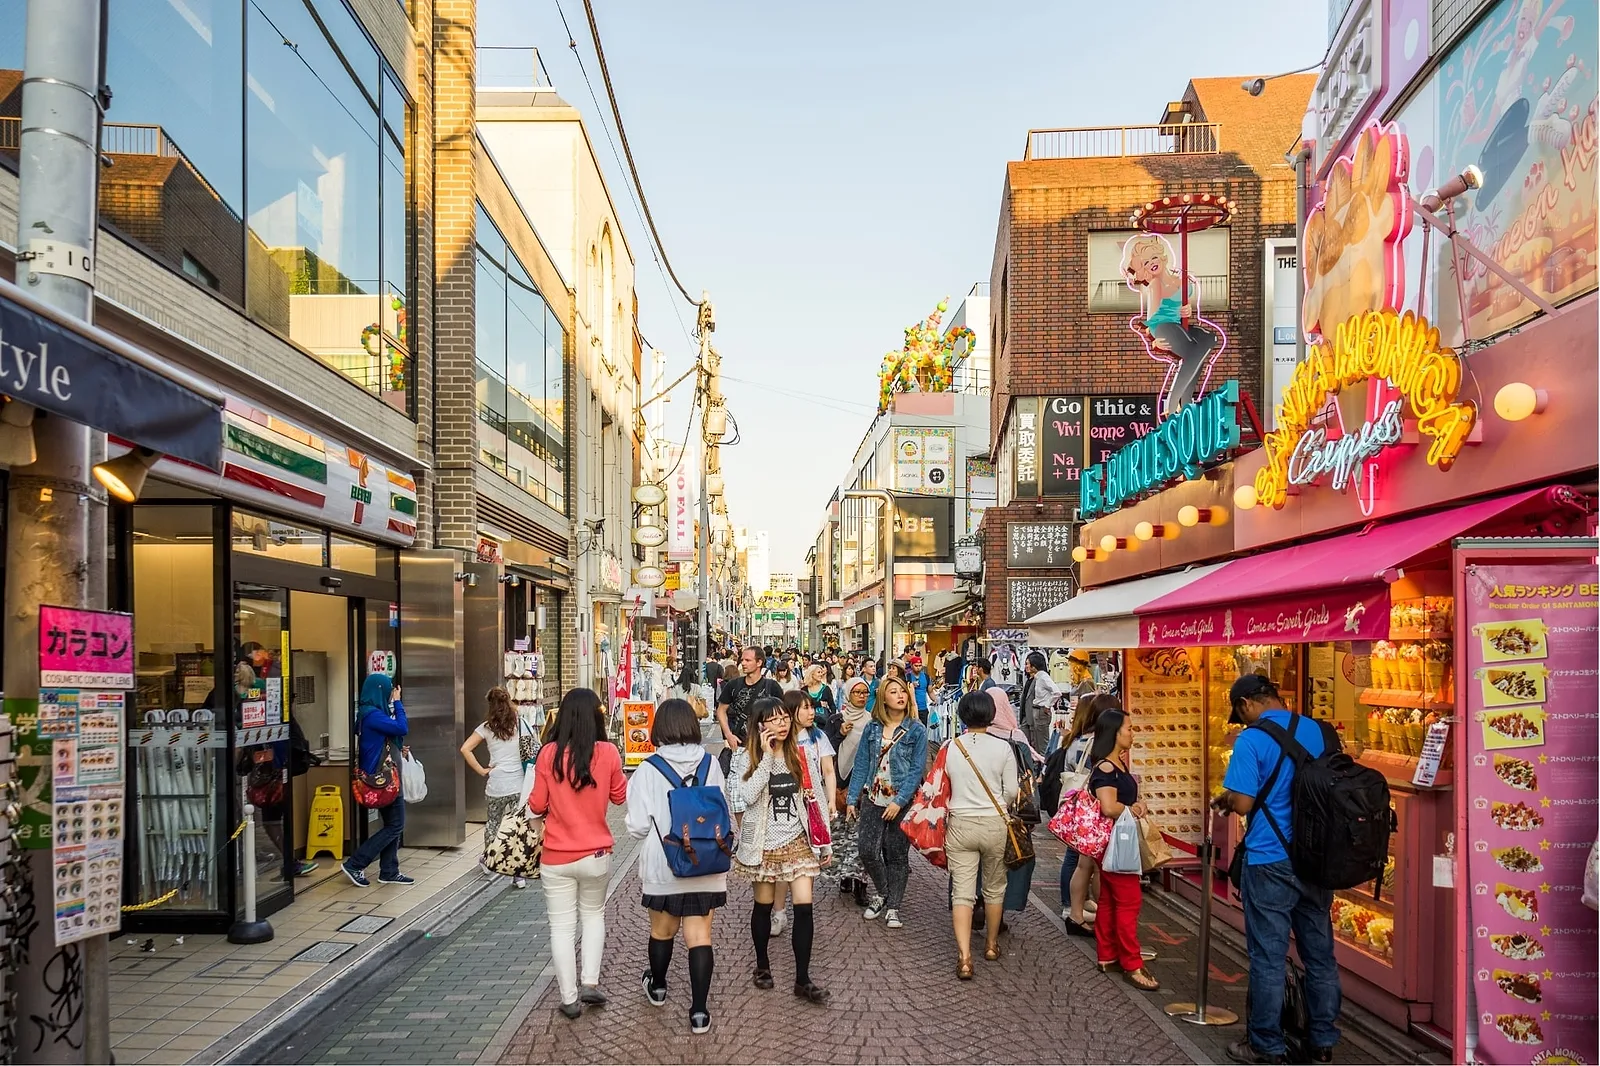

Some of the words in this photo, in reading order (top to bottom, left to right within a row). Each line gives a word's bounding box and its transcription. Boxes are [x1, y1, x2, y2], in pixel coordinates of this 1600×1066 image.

[1335, 308, 1474, 471] MONICA
[1017, 413, 1036, 482] 買取委託
[1103, 388, 1238, 510] BURLESQUE
[1489, 584, 1576, 598] 人気ランキング
[1489, 602, 1520, 610] Popular
[1303, 603, 1330, 637] Girls
[47, 625, 129, 659] カラコン
[85, 675, 114, 685] CONTACT
[115, 676, 131, 686] LENS
